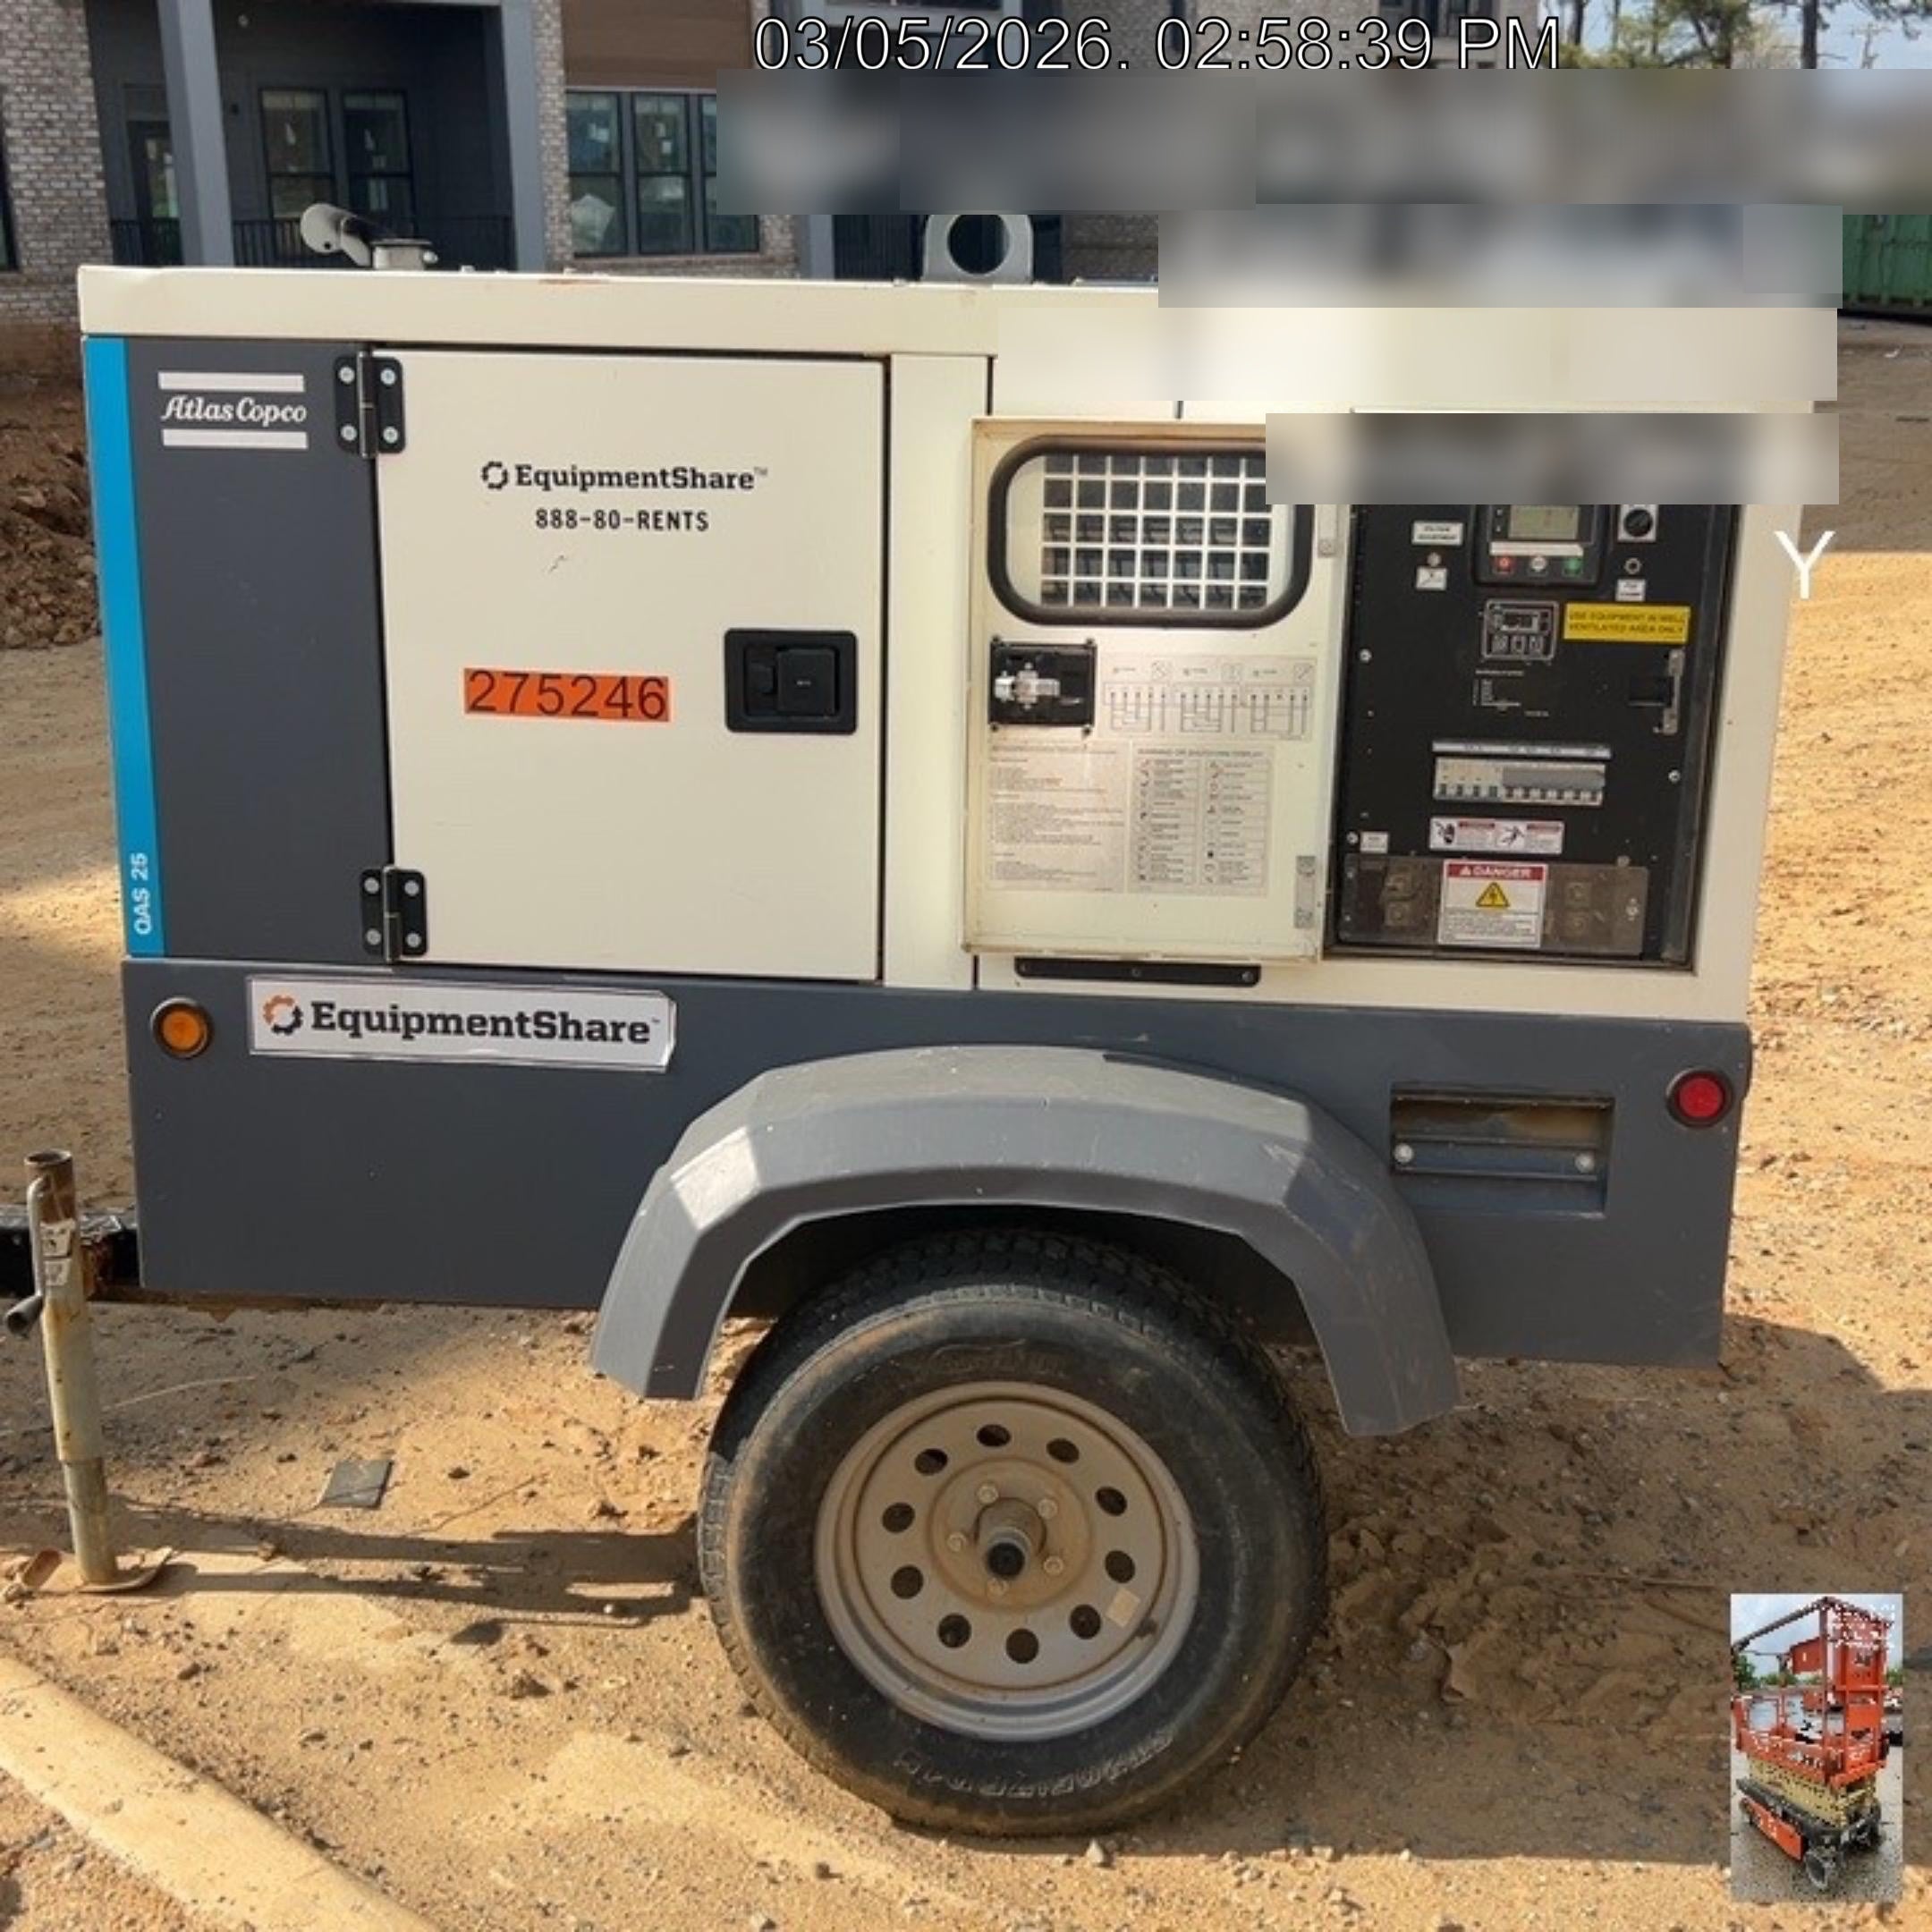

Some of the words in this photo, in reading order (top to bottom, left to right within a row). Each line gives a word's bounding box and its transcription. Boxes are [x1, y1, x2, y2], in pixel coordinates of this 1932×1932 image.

[161, 395, 235, 421] Atlas
[236, 396, 307, 427] Copco
[535, 507, 709, 532] 888-80-RENTS
[468, 670, 667, 721] 275246
[130, 852, 148, 881] 25
[1472, 866, 1531, 878] DANGER
[131, 886, 152, 936] QAS
